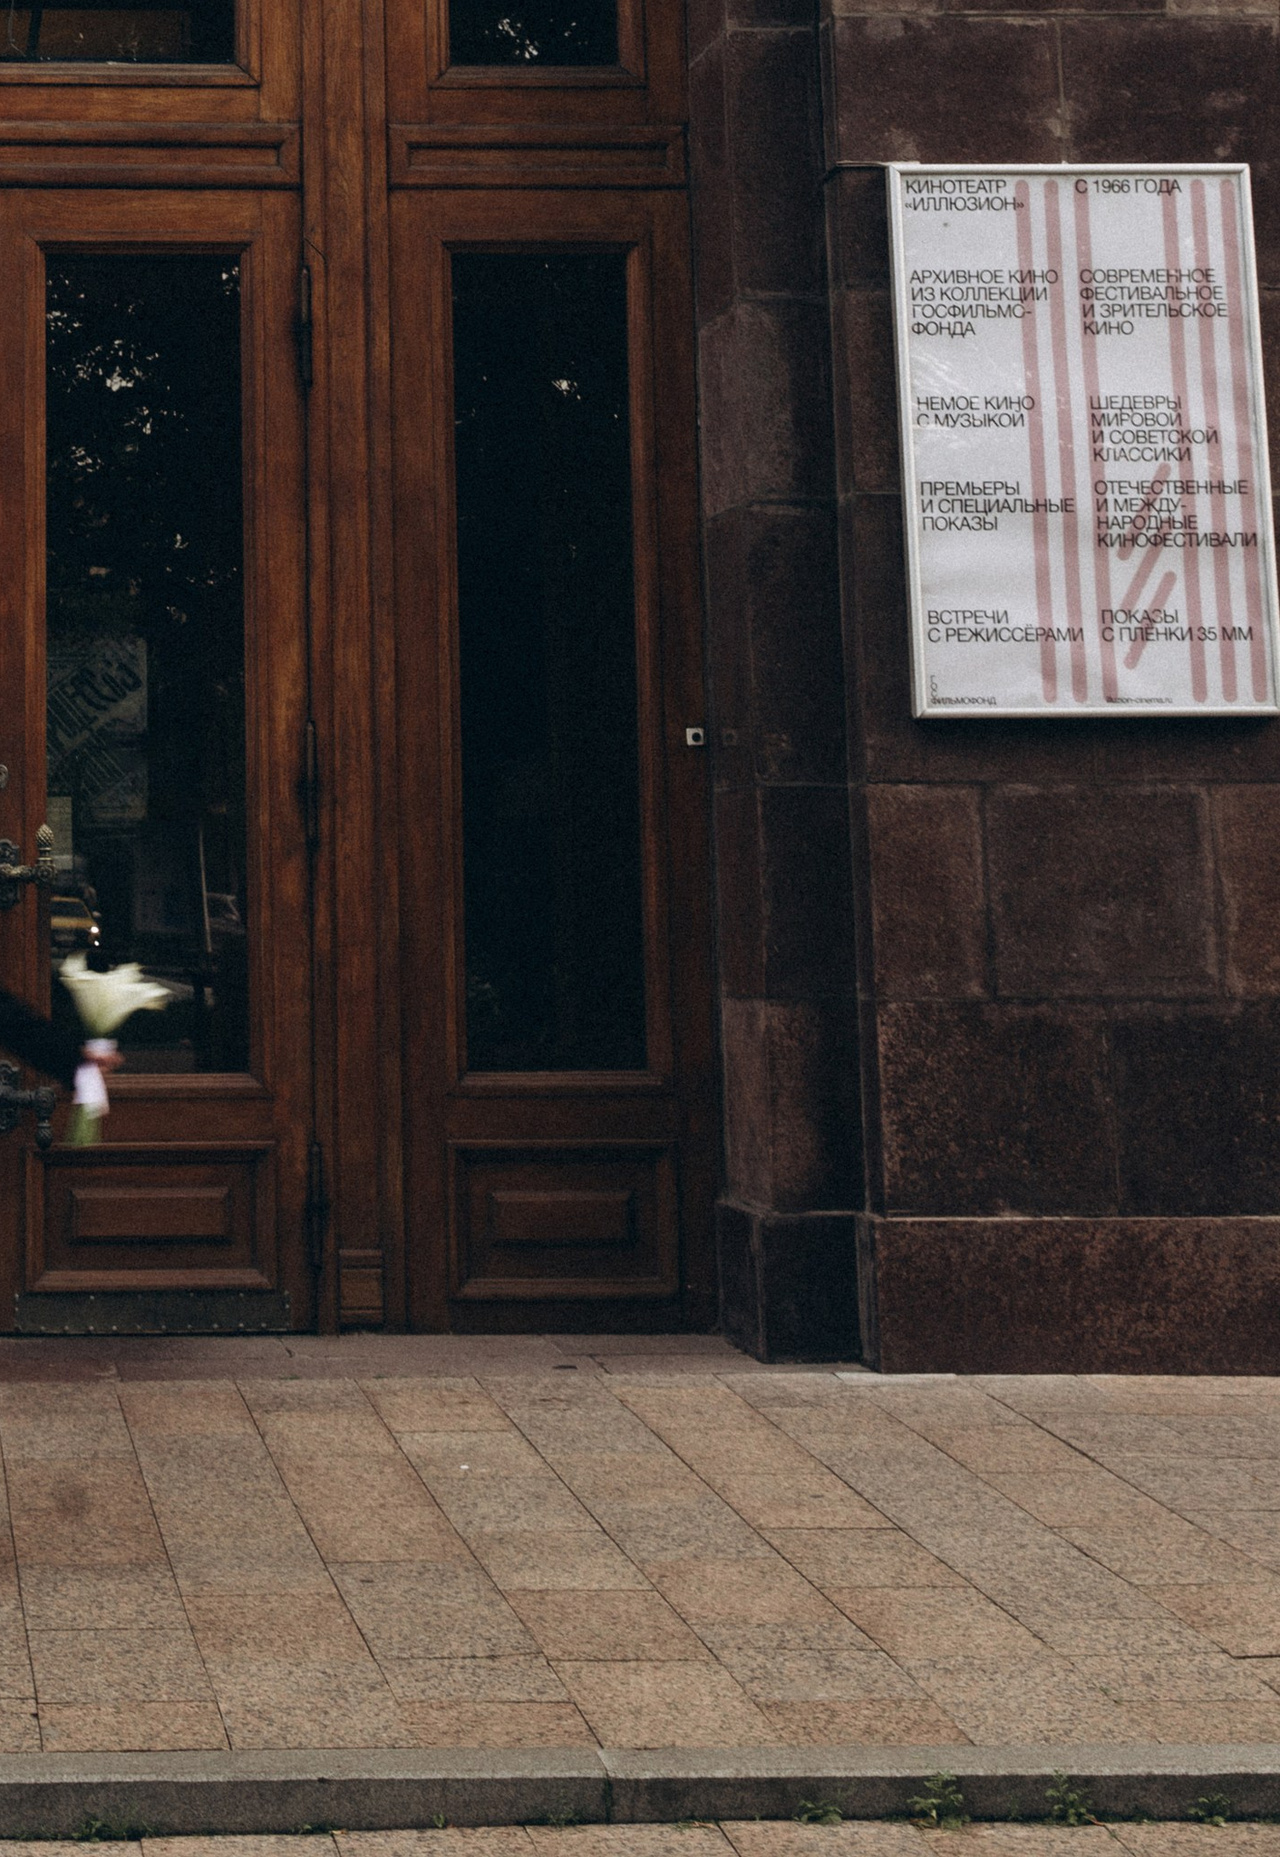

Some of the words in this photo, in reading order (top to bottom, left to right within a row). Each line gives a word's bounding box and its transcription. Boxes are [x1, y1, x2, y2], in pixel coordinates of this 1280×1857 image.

[905, 179, 1007, 194] КИНОТЕАТР
[1075, 178, 1088, 194] С
[1093, 178, 1131, 194] 1966
[1135, 178, 1182, 196] ГОДА
[904, 196, 1025, 211] «ИЛЛЮЗИОН»
[909, 270, 1004, 284] АРХИВНОЕ
[1008, 269, 1059, 284] КИНО
[1080, 269, 1216, 284] СОВРЕМЕННОЕ
[911, 287, 936, 301] ИЗ
[940, 287, 1048, 303] КОЛЛЕКЦИИ
[1080, 286, 1224, 301] ФЕСТИВАЛЬНОЕ
[912, 304, 1032, 319] ГОСФИЛЬМО-
[1083, 303, 1095, 318] И
[1100, 303, 1229, 318] ЗРИТЕЛЬСКОЕ
[911, 321, 976, 339] ФОНДА
[1083, 320, 1134, 335] КИНО
[916, 395, 980, 411] НЕМОЕ
[984, 395, 1035, 411] КИНО
[1090, 395, 1182, 412] ШЕДЕВРЫ
[917, 413, 930, 428] С
[934, 410, 1025, 428] МУЗЫКОЙ
[1091, 409, 1182, 427] МИРОВОЙ
[1092, 430, 1104, 444] И
[1109, 425, 1218, 444] СОВЕТСКОЙ
[1093, 447, 1191, 462] КЛАССИКИ
[920, 481, 1020, 496] ПРЕМЬЕРЫ
[1094, 480, 1249, 495] ОТЕЧЕСТВЕННЫЕ
[921, 499, 933, 513] И
[938, 498, 1075, 516] СПЕЦИАЛЬНЫЕ
[1096, 498, 1108, 512] И
[1114, 497, 1187, 515] МЕЖДУ-
[922, 516, 998, 531] ПОКАЗЫ
[1097, 515, 1198, 533] НАРОДНЫЕ
[1097, 532, 1258, 548] КИНОФЕСТИВАЛИ
[928, 610, 1009, 625] ВСТРЕЧИ
[1101, 609, 1179, 624] ПОКАЗЫ
[928, 627, 941, 643] С
[946, 624, 1084, 643] РЕЖИССЁРАМИ
[1102, 626, 1115, 642] С
[1197, 626, 1217, 642] 35
[1222, 626, 1254, 641] ММ
